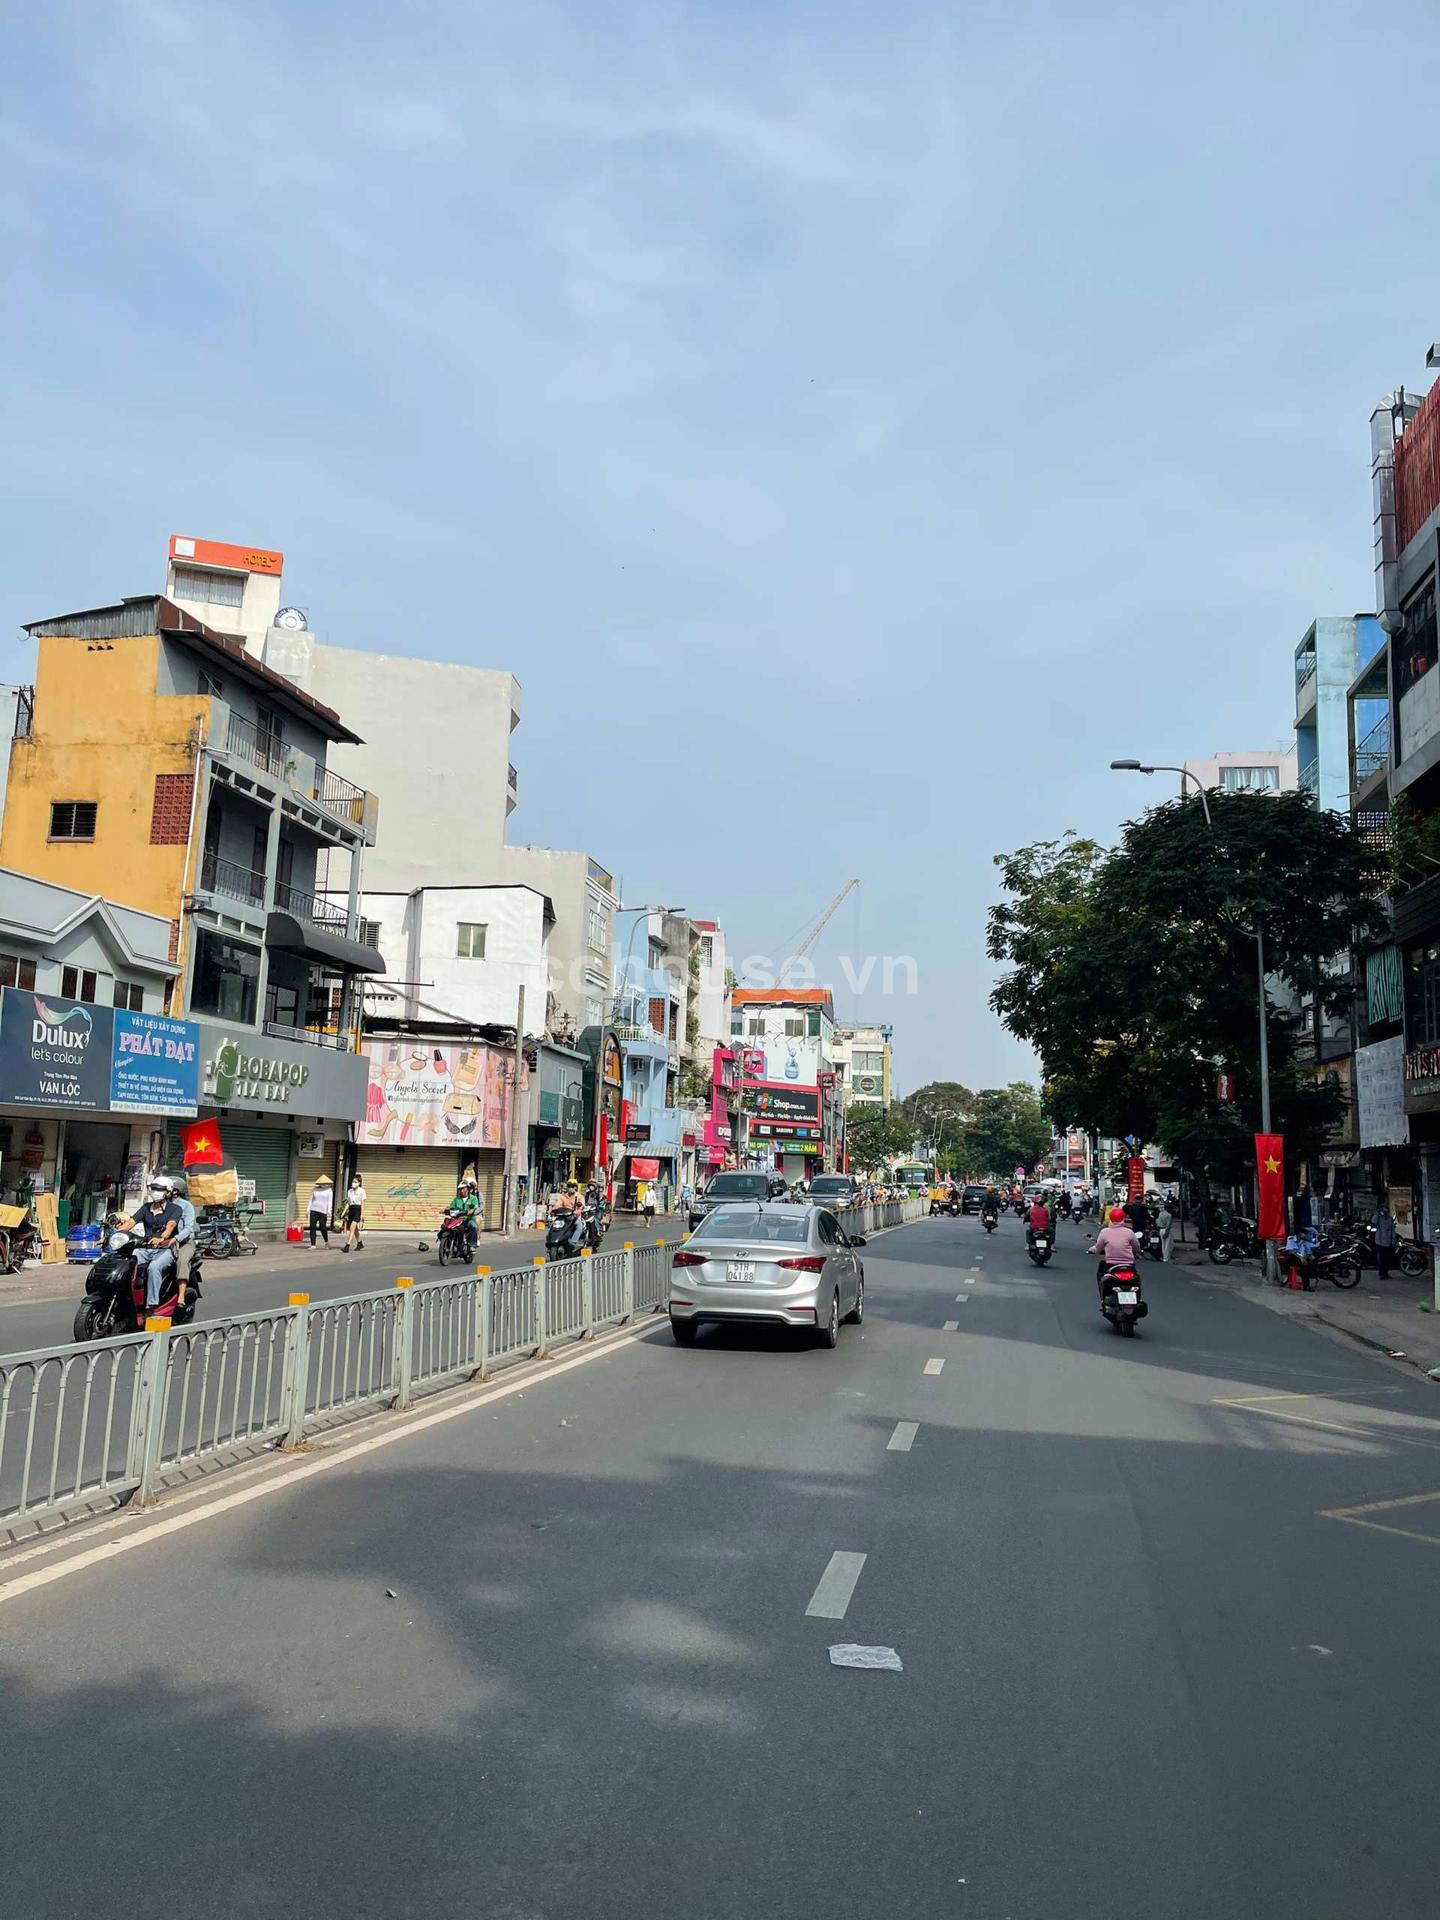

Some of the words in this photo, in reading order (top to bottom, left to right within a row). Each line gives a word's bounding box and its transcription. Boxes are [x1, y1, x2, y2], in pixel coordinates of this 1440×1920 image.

[243, 553, 272, 568] HOTEL
[32, 1019, 84, 1050] Dulux
[132, 1016, 144, 1029] VẬT
[144, 1019, 158, 1031] LIỆU
[158, 1020, 170, 1031] XÂY
[170, 1024, 186, 1035] DỰNG
[31, 1046, 51, 1062] let's
[53, 1051, 84, 1065] colour
[119, 1030, 163, 1057] PHÁT
[164, 1039, 195, 1064] ĐẠT
[237, 1055, 310, 1086] BOBAPOP
[39, 1080, 59, 1095] VẠN
[61, 1082, 80, 1097] LỘC
[236, 1081, 260, 1099] TEA
[265, 1084, 289, 1103] BAR
[421, 1082, 447, 1095] Secret
